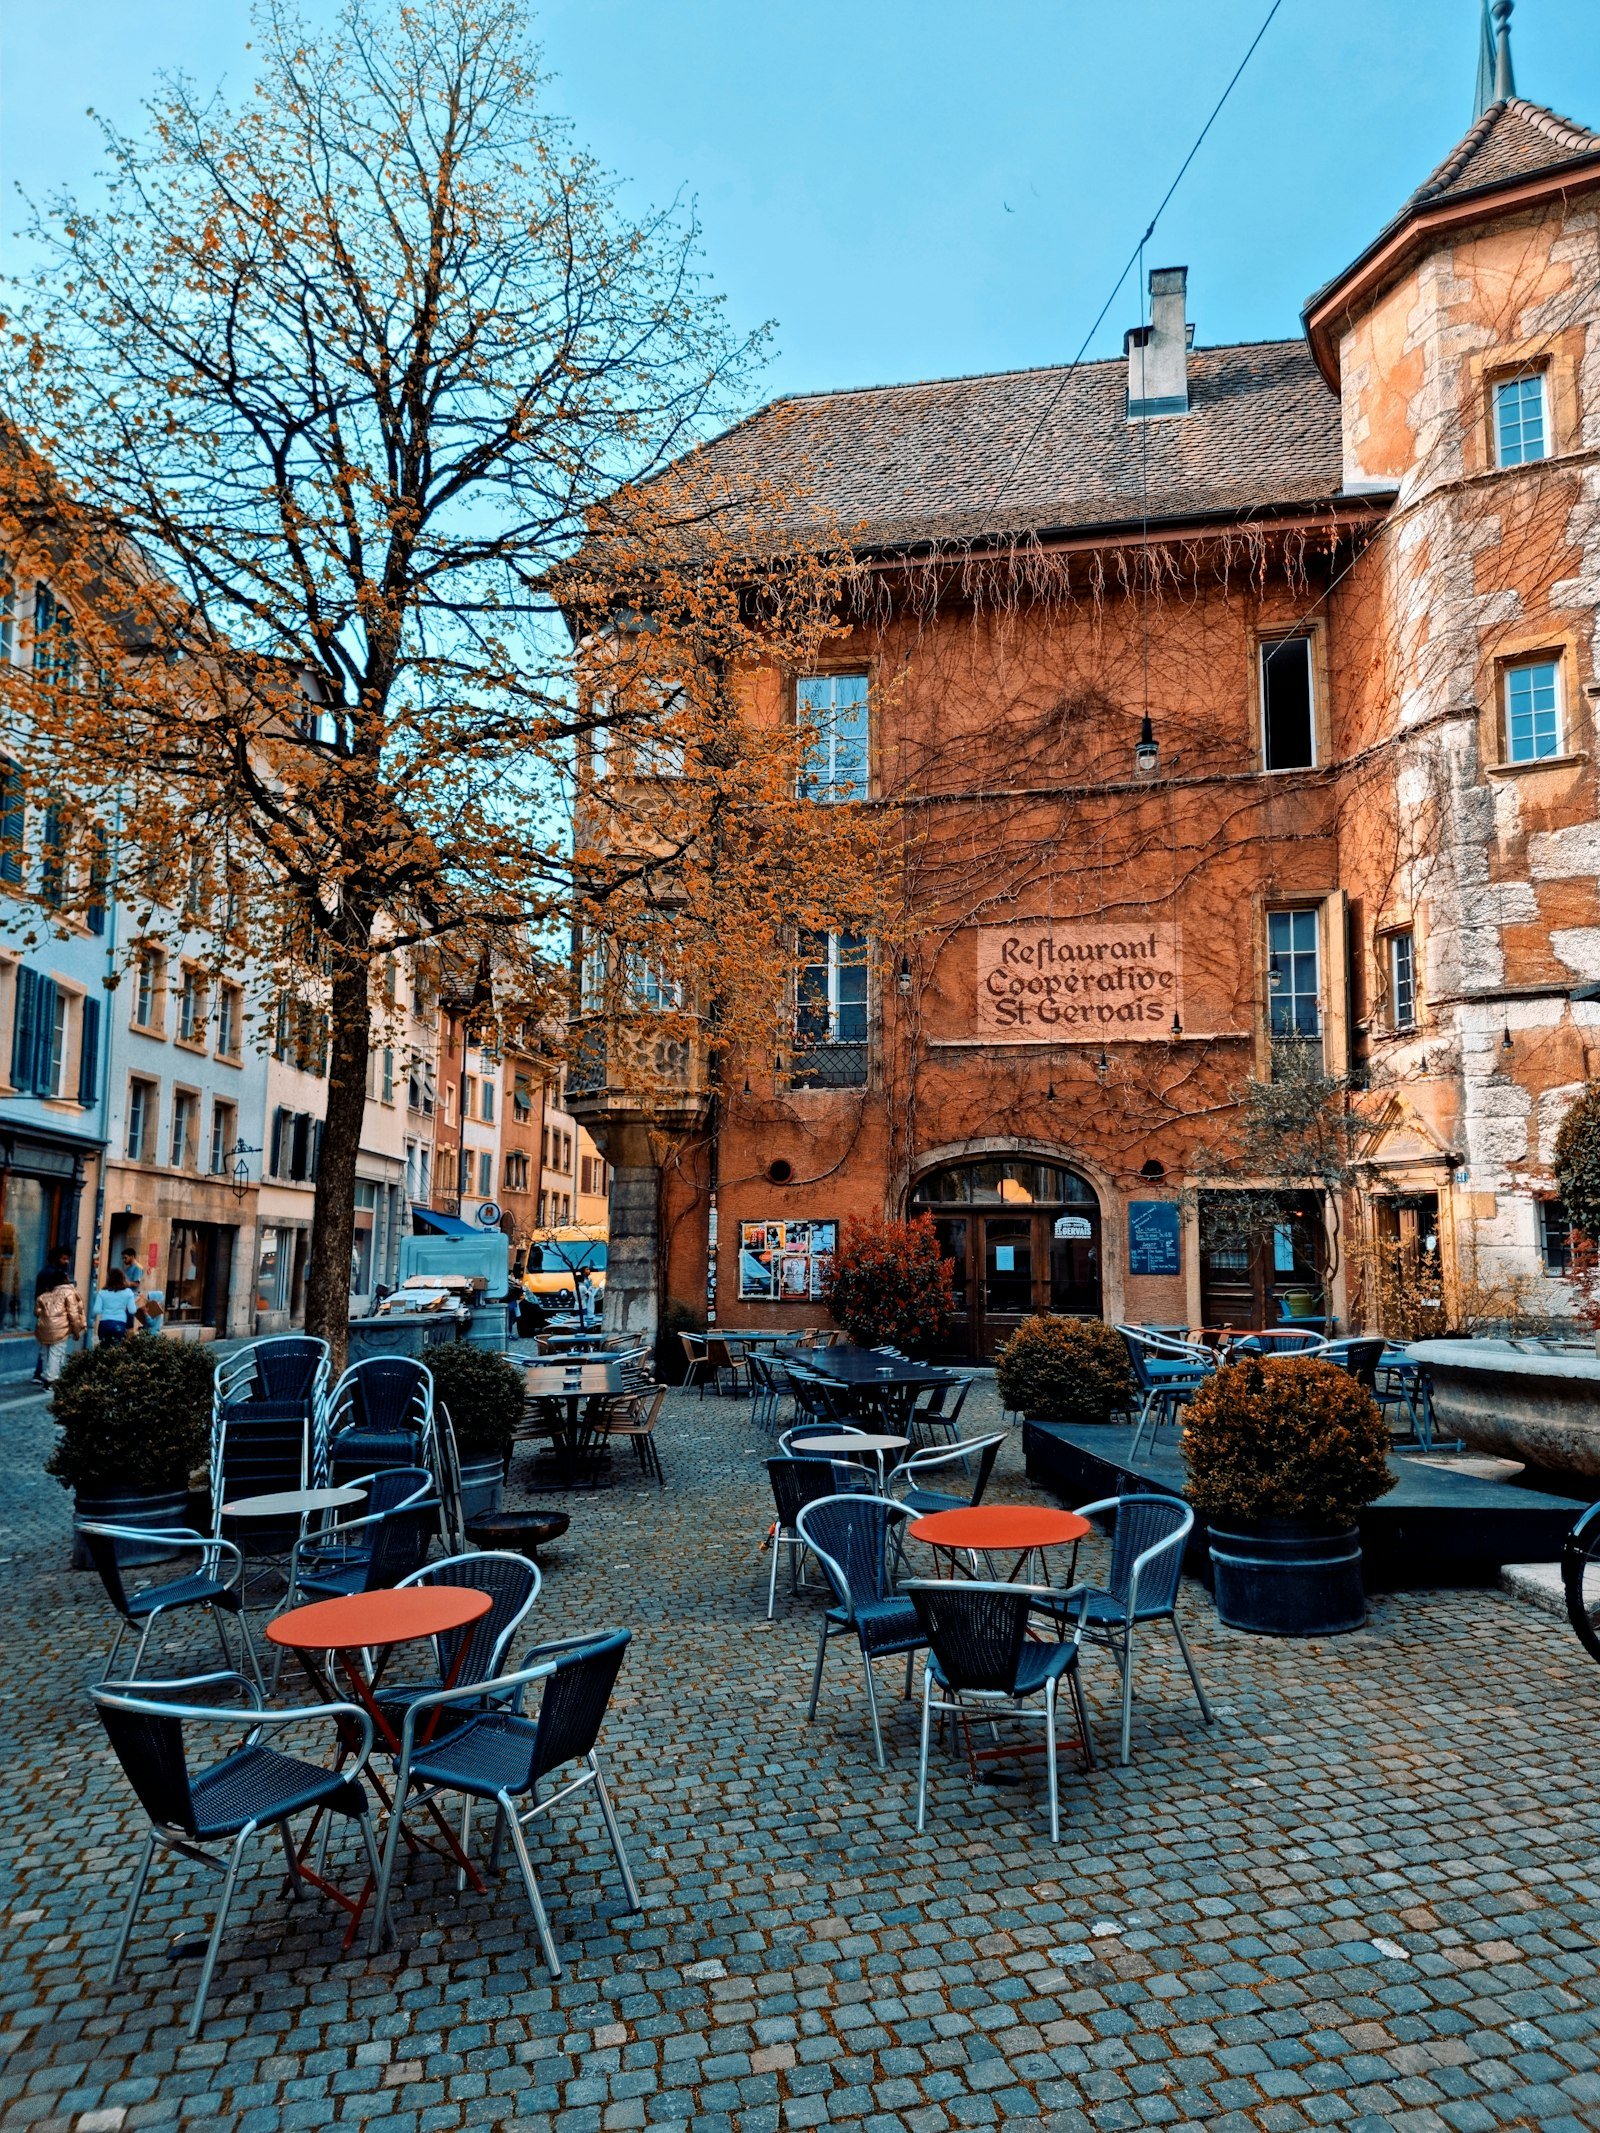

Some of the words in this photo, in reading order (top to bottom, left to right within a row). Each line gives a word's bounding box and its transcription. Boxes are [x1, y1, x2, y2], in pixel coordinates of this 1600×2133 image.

[986, 965, 1175, 997] Coopérative
[995, 998, 1032, 1026] St.
[1037, 997, 1165, 1024] Gervais
[1062, 1227, 1091, 1236] GERVAIS
